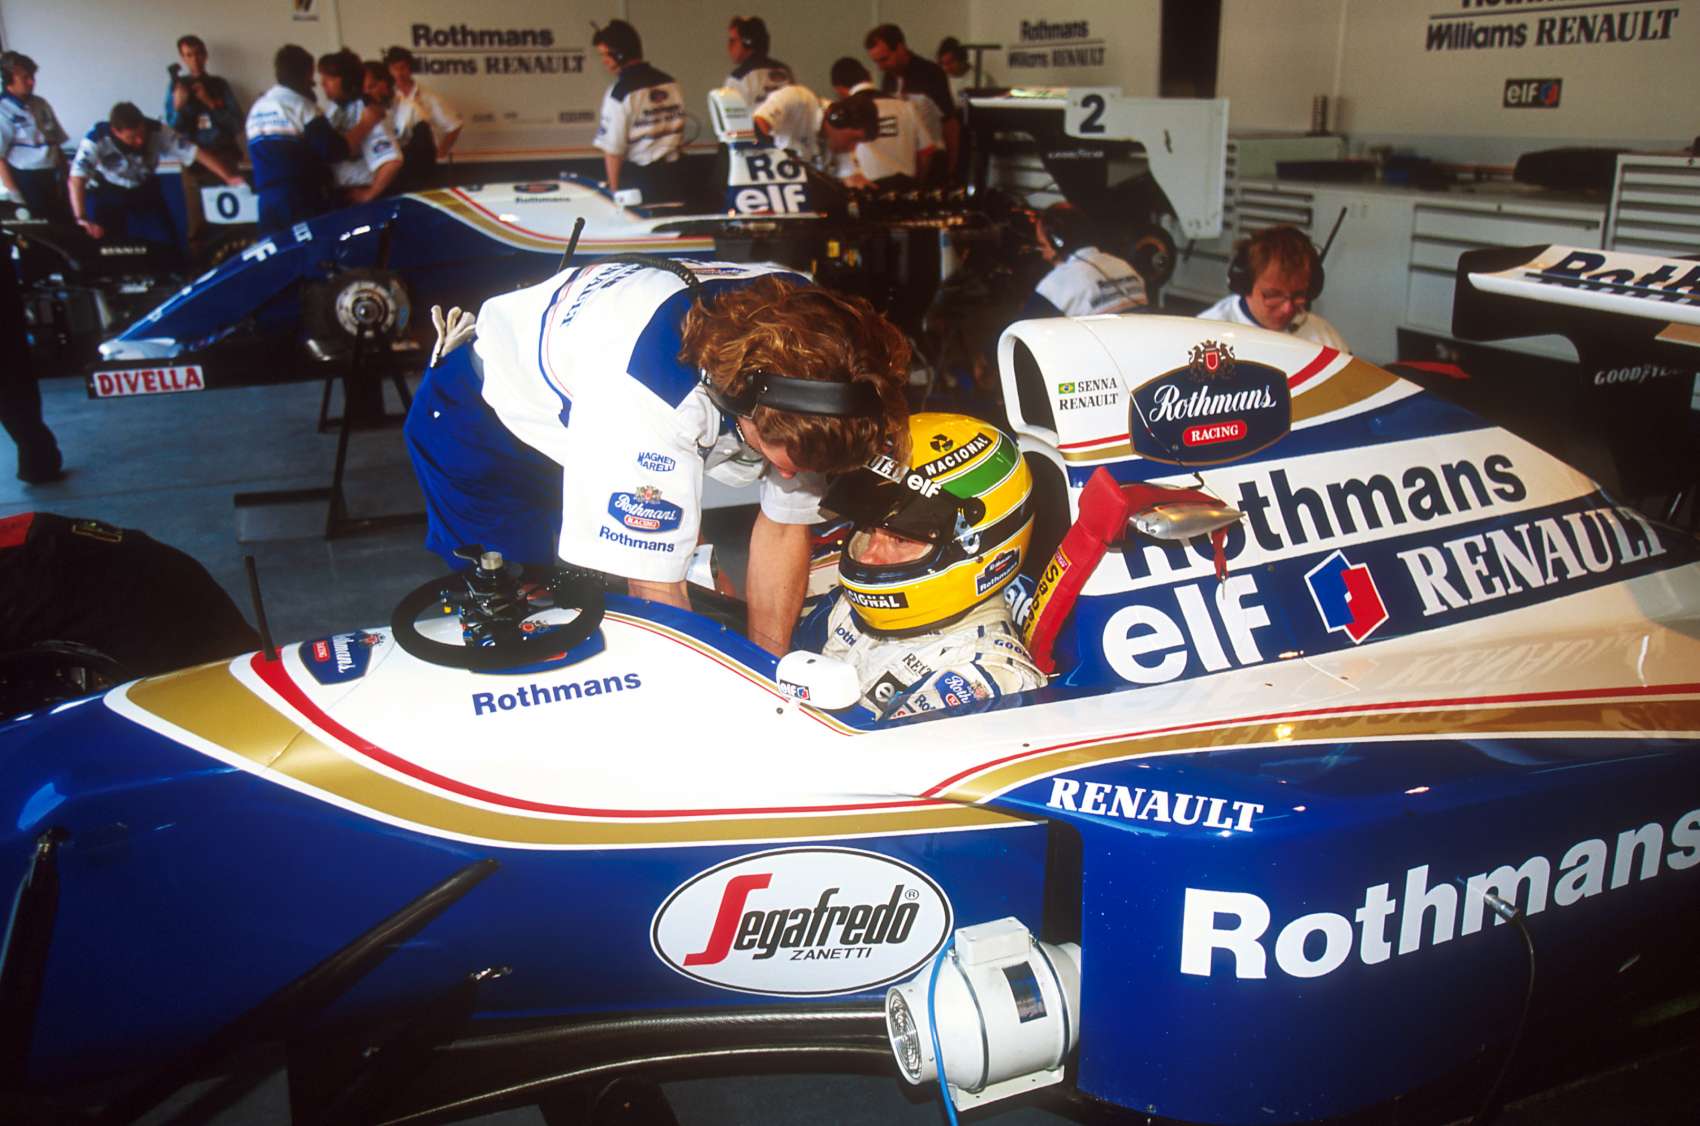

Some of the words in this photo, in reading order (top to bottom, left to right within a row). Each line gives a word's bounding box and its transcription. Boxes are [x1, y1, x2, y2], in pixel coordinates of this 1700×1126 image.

[412, 24, 554, 47] Rothmans
[1425, 21, 1528, 50] Williams
[1535, 9, 1680, 46] RENAULT
[485, 55, 584, 74] RENAULT
[1506, 82, 1539, 104] elf
[1079, 94, 1106, 134] 2
[216, 191, 240, 219] 0
[735, 184, 806, 214] elf
[97, 366, 202, 396] DIVELLA
[1078, 377, 1118, 393] SENNA
[1059, 392, 1119, 411] RENAULT
[1150, 384, 1277, 422] Rothmans
[1191, 424, 1240, 442] RACING
[924, 436, 989, 476] NACIONAL
[907, 474, 942, 498] elf
[614, 494, 678, 521] Rothmans
[599, 525, 675, 552] Rothmans
[1398, 506, 1667, 617] RENAULT
[1102, 574, 1271, 684] elf
[472, 672, 642, 716] Rothmans
[1046, 777, 1265, 832] RENAULT
[1181, 808, 1700, 980] Rothmans
[682, 873, 920, 967] Segafredo
[789, 947, 873, 961] ZANETTI
